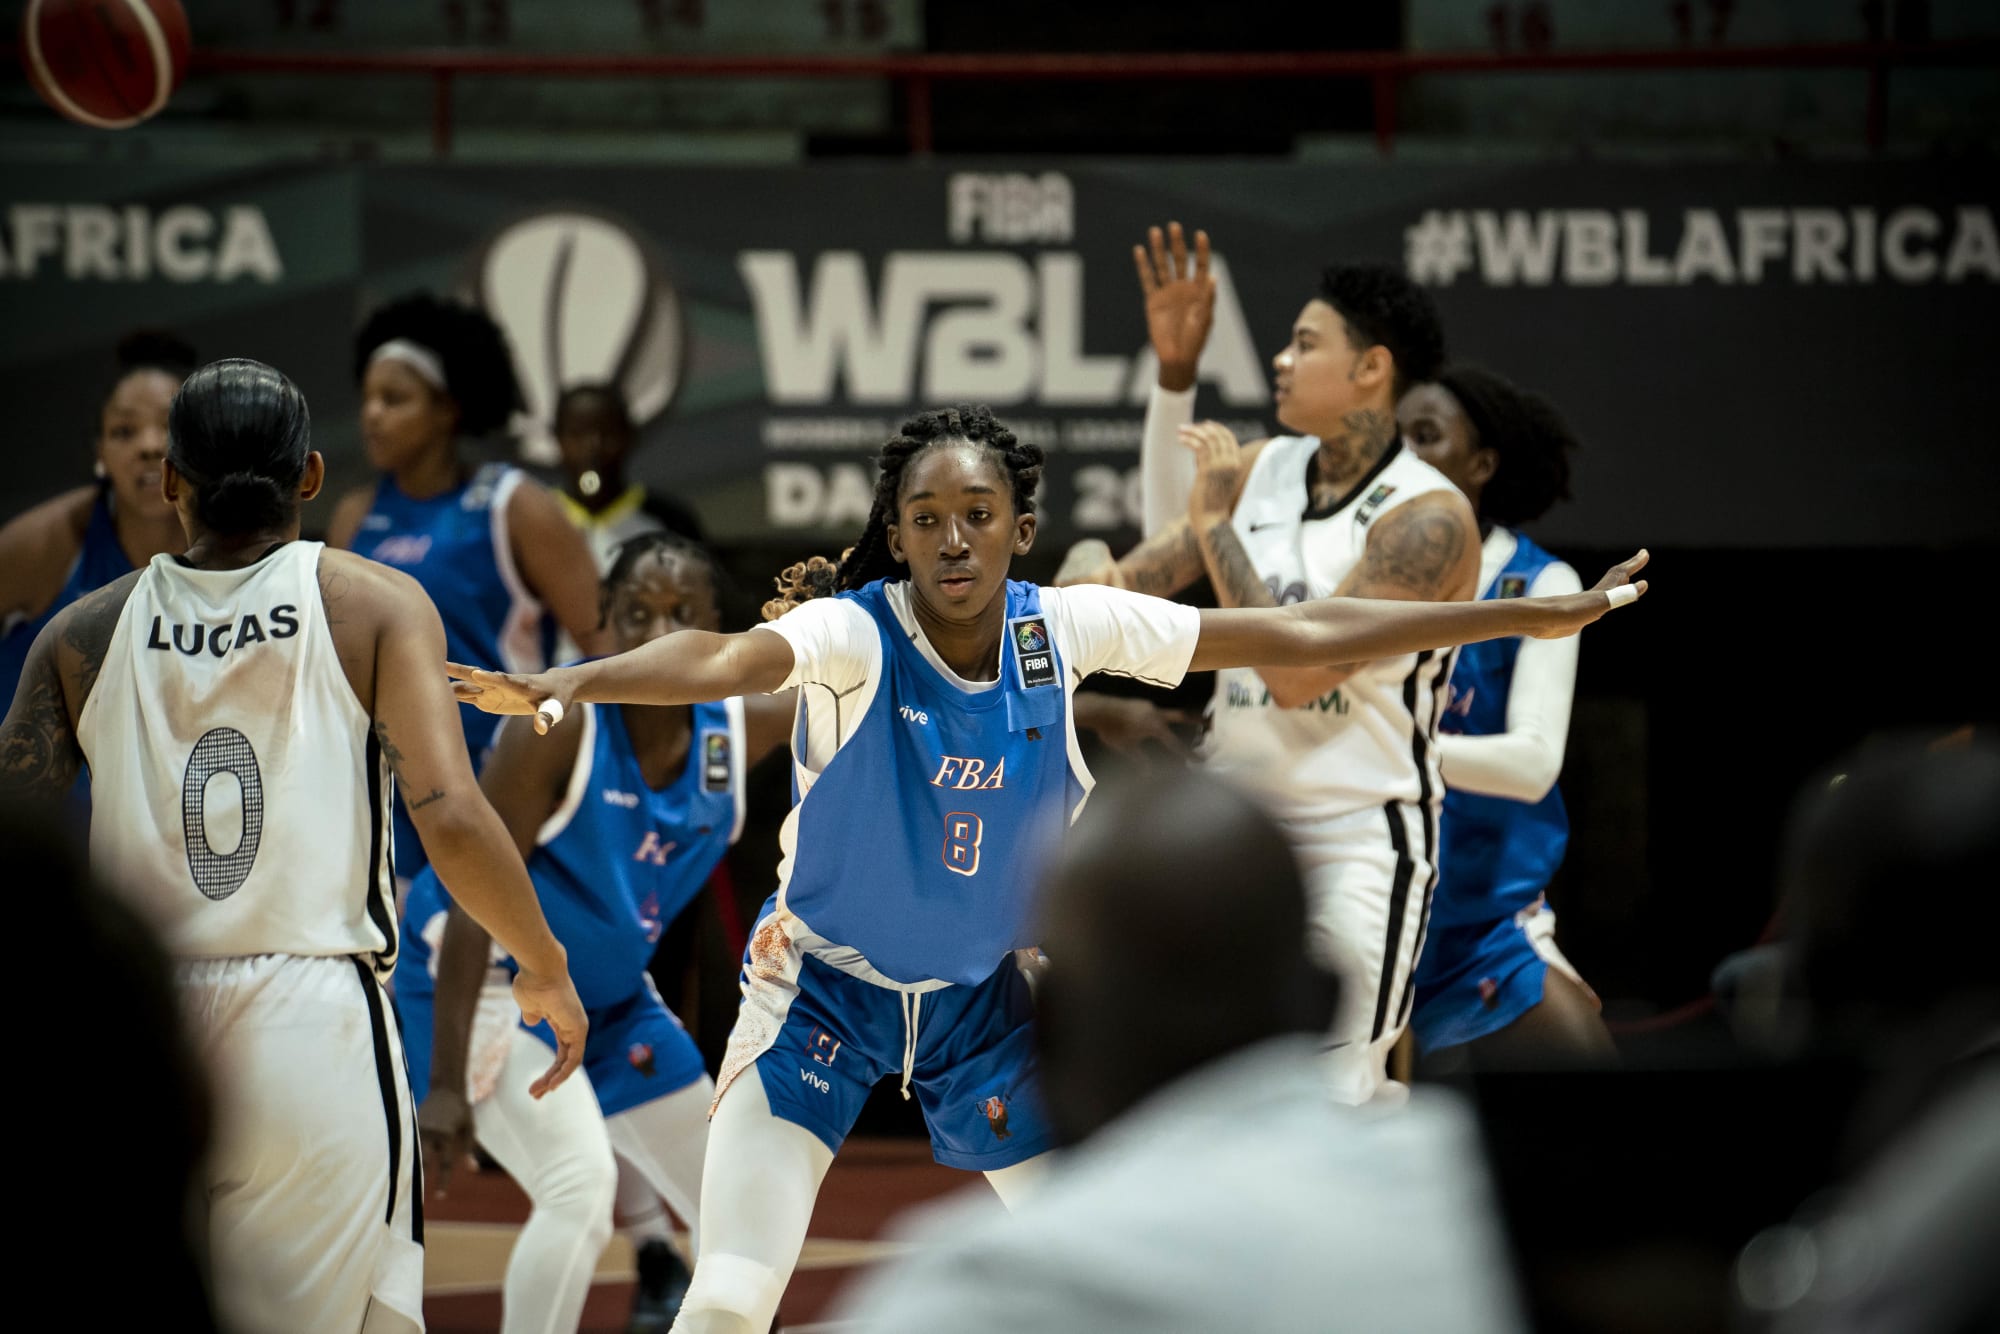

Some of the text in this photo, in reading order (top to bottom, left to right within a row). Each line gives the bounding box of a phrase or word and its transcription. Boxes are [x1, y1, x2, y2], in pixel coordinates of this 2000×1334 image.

[0, 203, 284, 282] FRICA
[1404, 205, 2000, 287] #WBLAFRICA
[147, 604, 299, 658] LUCAS
[1025, 656, 1049, 671] FIBA
[929, 755, 1006, 790] FBA
[182, 727, 264, 901] 0
[942, 811, 983, 877] 8
[800, 1067, 830, 1094] vive
